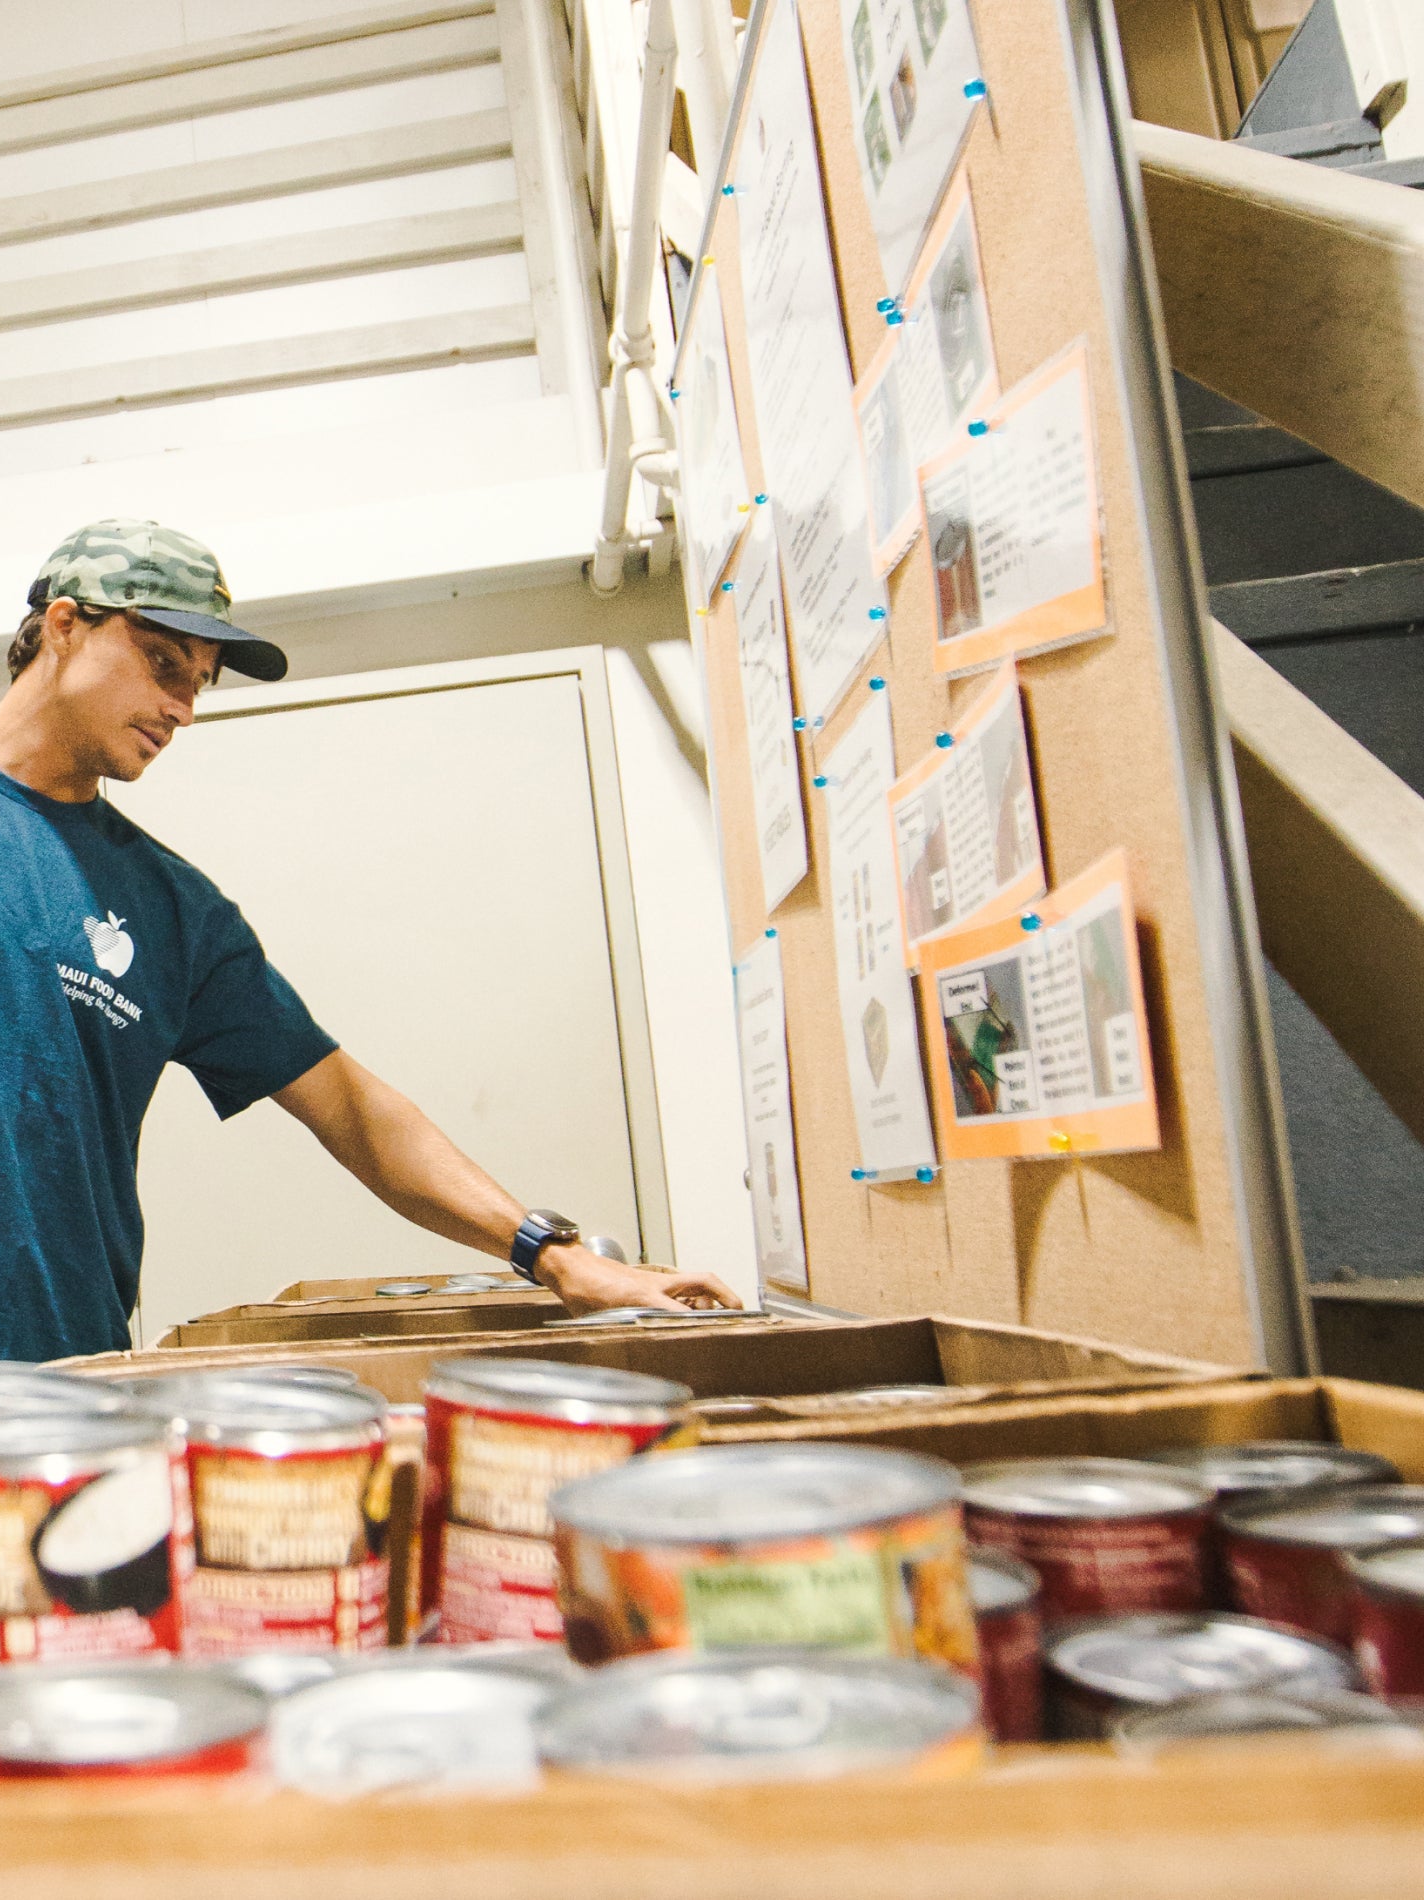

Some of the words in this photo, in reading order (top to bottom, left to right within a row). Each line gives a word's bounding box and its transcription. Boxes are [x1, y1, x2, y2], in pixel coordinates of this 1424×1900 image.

[56, 963, 89, 986] MAUI
[89, 976, 115, 1000] FOOD
[113, 993, 142, 1022] BANK
[61, 982, 95, 1007] Helping
[104, 1004, 129, 1030] hungry
